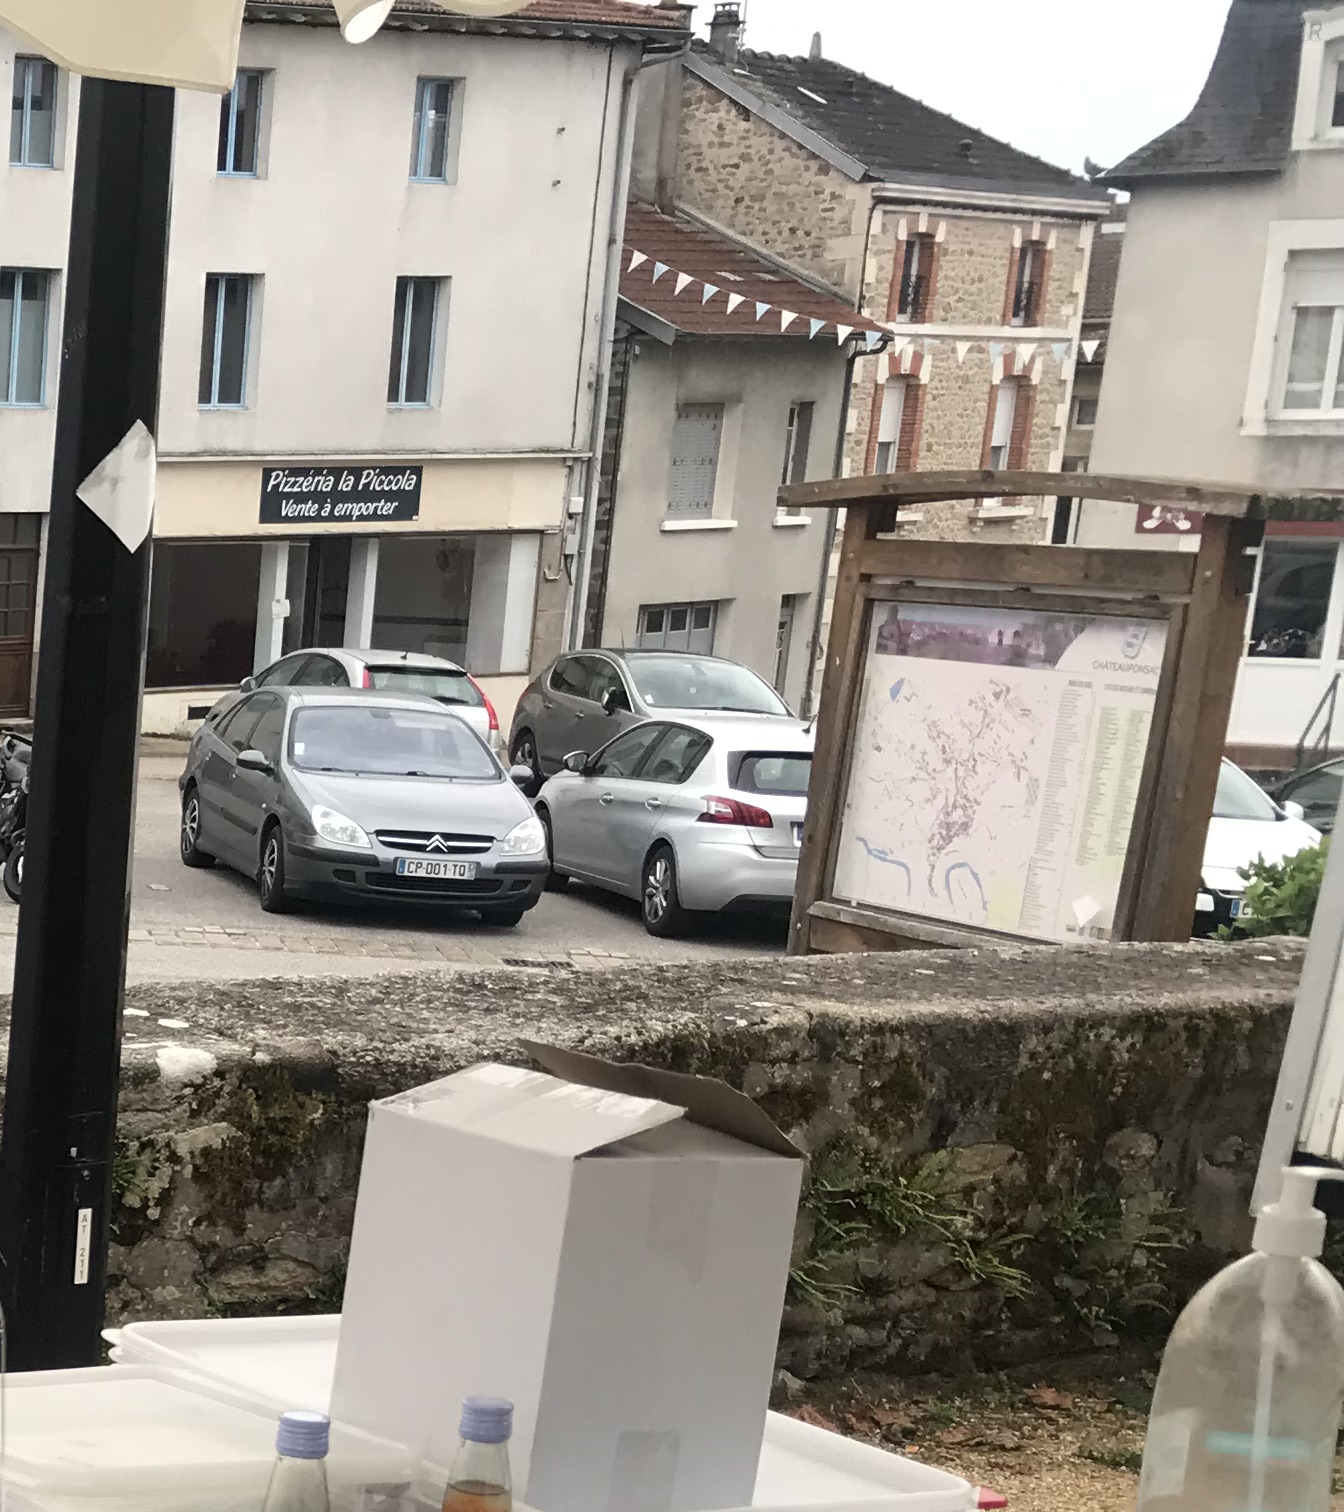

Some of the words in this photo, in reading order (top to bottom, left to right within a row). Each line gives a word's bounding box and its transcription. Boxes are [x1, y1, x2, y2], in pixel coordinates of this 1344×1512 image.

[266, 469, 334, 493] Pizzéria
[337, 470, 355, 492] la
[357, 468, 417, 491] Piccola
[281, 498, 318, 517] Vente
[320, 498, 331, 516] à
[334, 499, 398, 520] emporter
